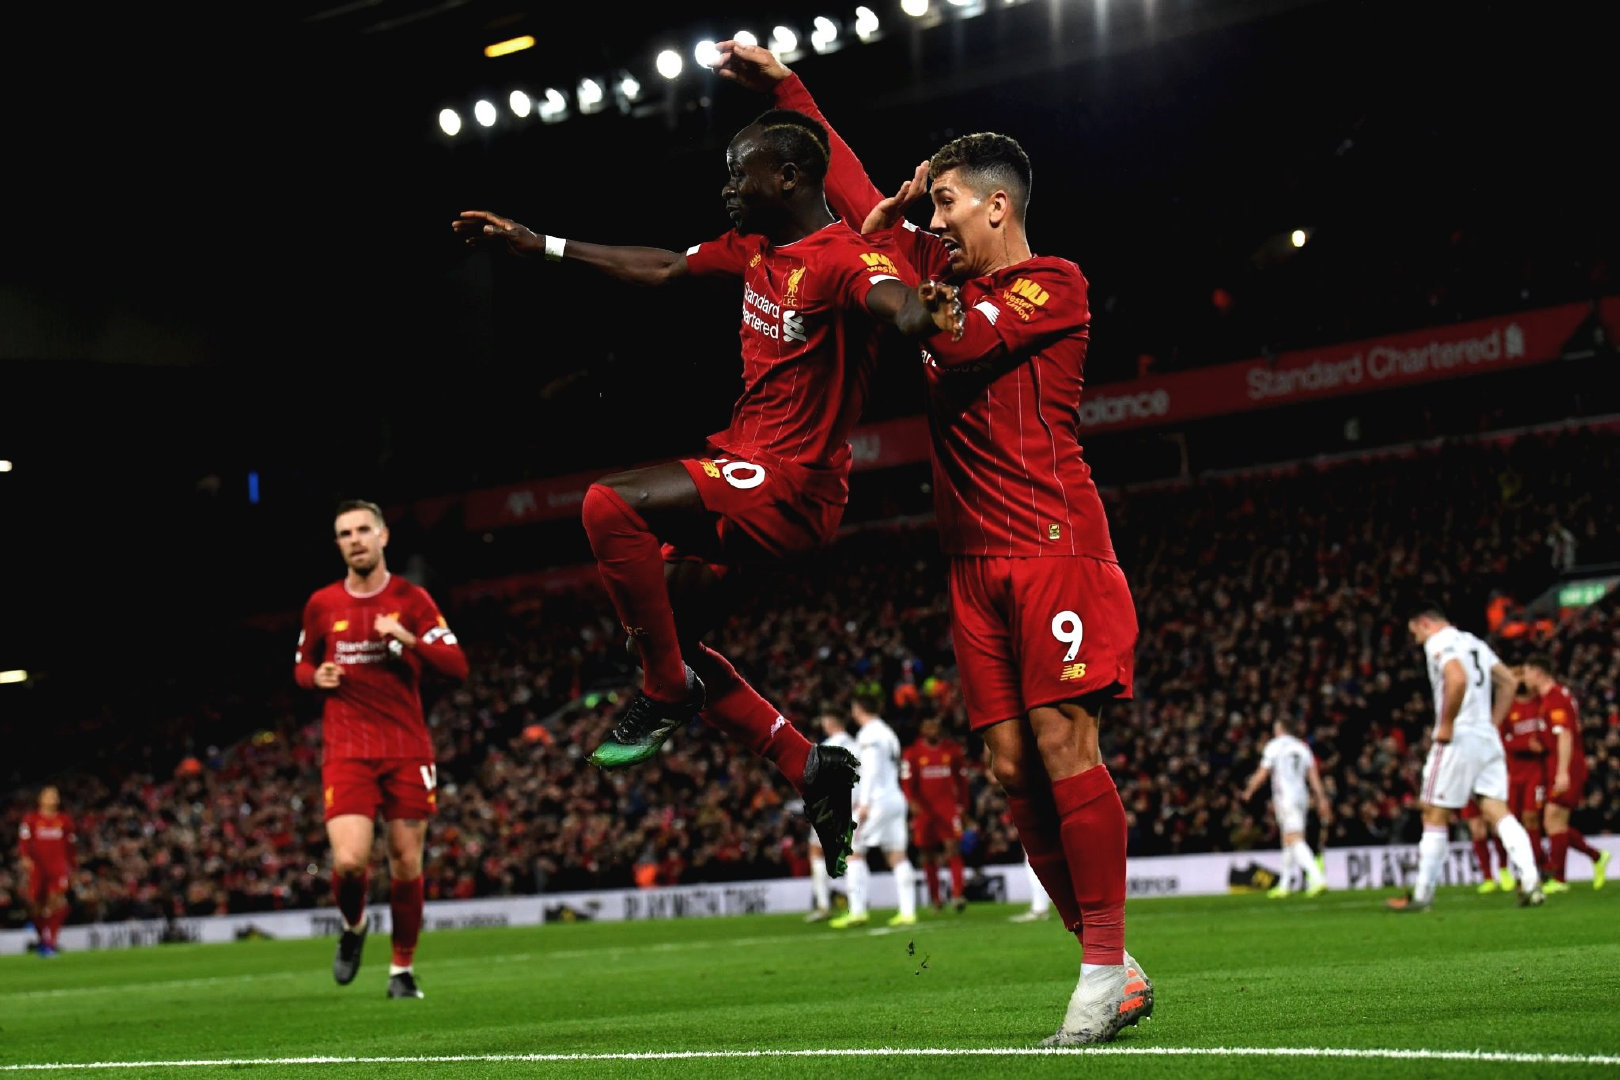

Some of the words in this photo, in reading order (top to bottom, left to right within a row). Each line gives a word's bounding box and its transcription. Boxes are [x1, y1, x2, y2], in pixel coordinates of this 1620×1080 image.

[1010, 277, 1050, 306] WU
[1246, 352, 1363, 401] Standard
[1366, 329, 1501, 380] Chartered
[1051, 610, 1084, 662] 9
[1469, 649, 1485, 687] 3
